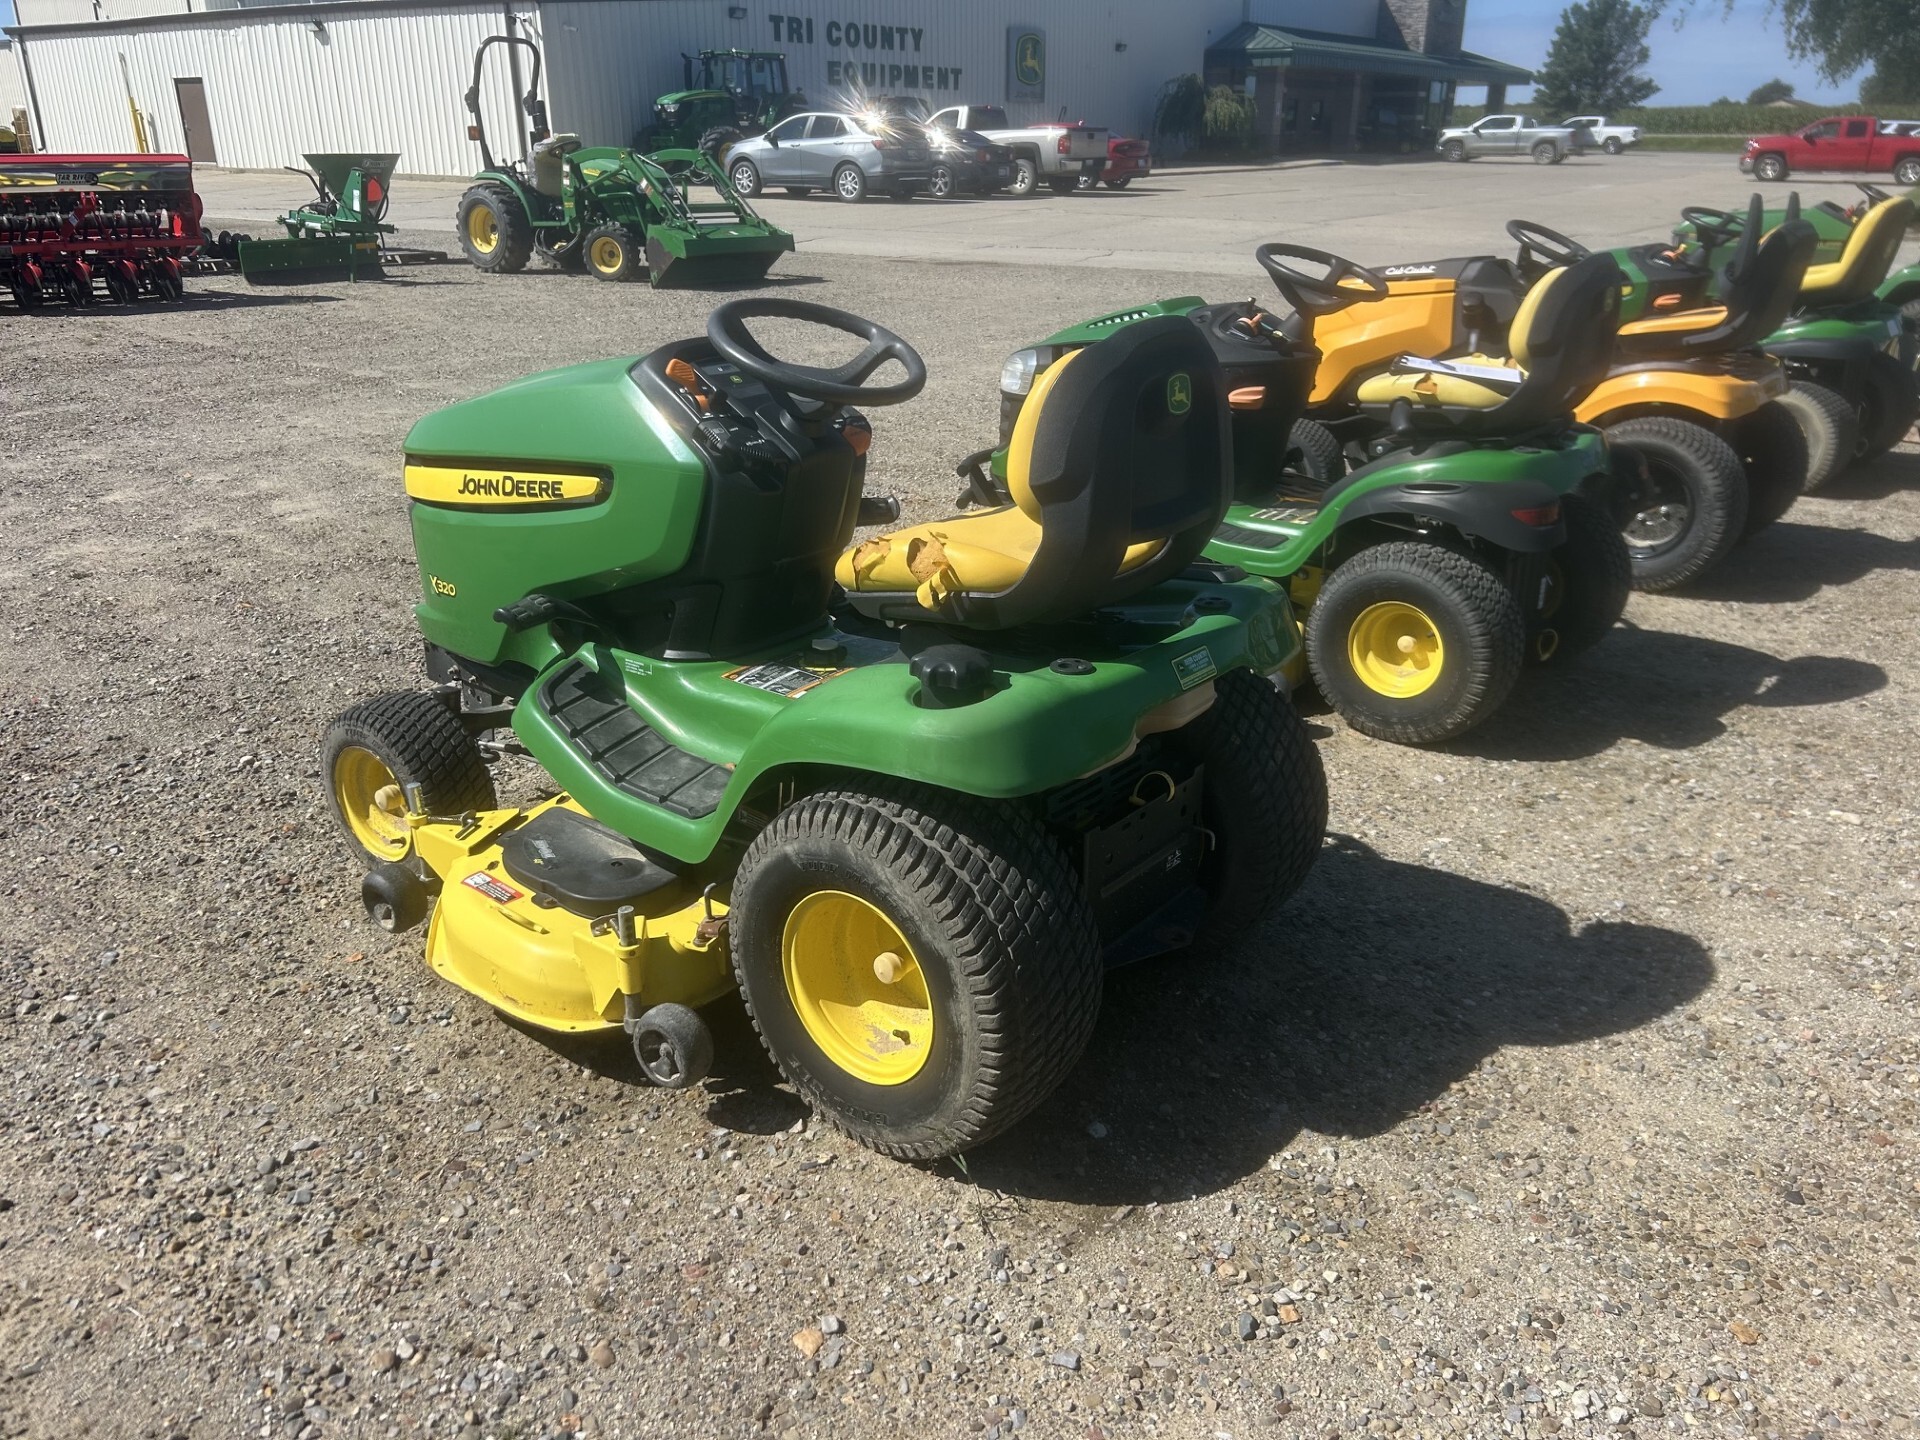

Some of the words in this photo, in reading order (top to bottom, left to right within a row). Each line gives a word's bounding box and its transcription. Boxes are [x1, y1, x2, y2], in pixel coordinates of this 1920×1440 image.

[769, 14, 814, 44] TRI
[826, 21, 924, 52] COUNTY
[827, 60, 963, 91] EQUIPMENT
[458, 473, 501, 496] JOHN
[502, 475, 564, 500] DEERE
[429, 574, 456, 598] X320
